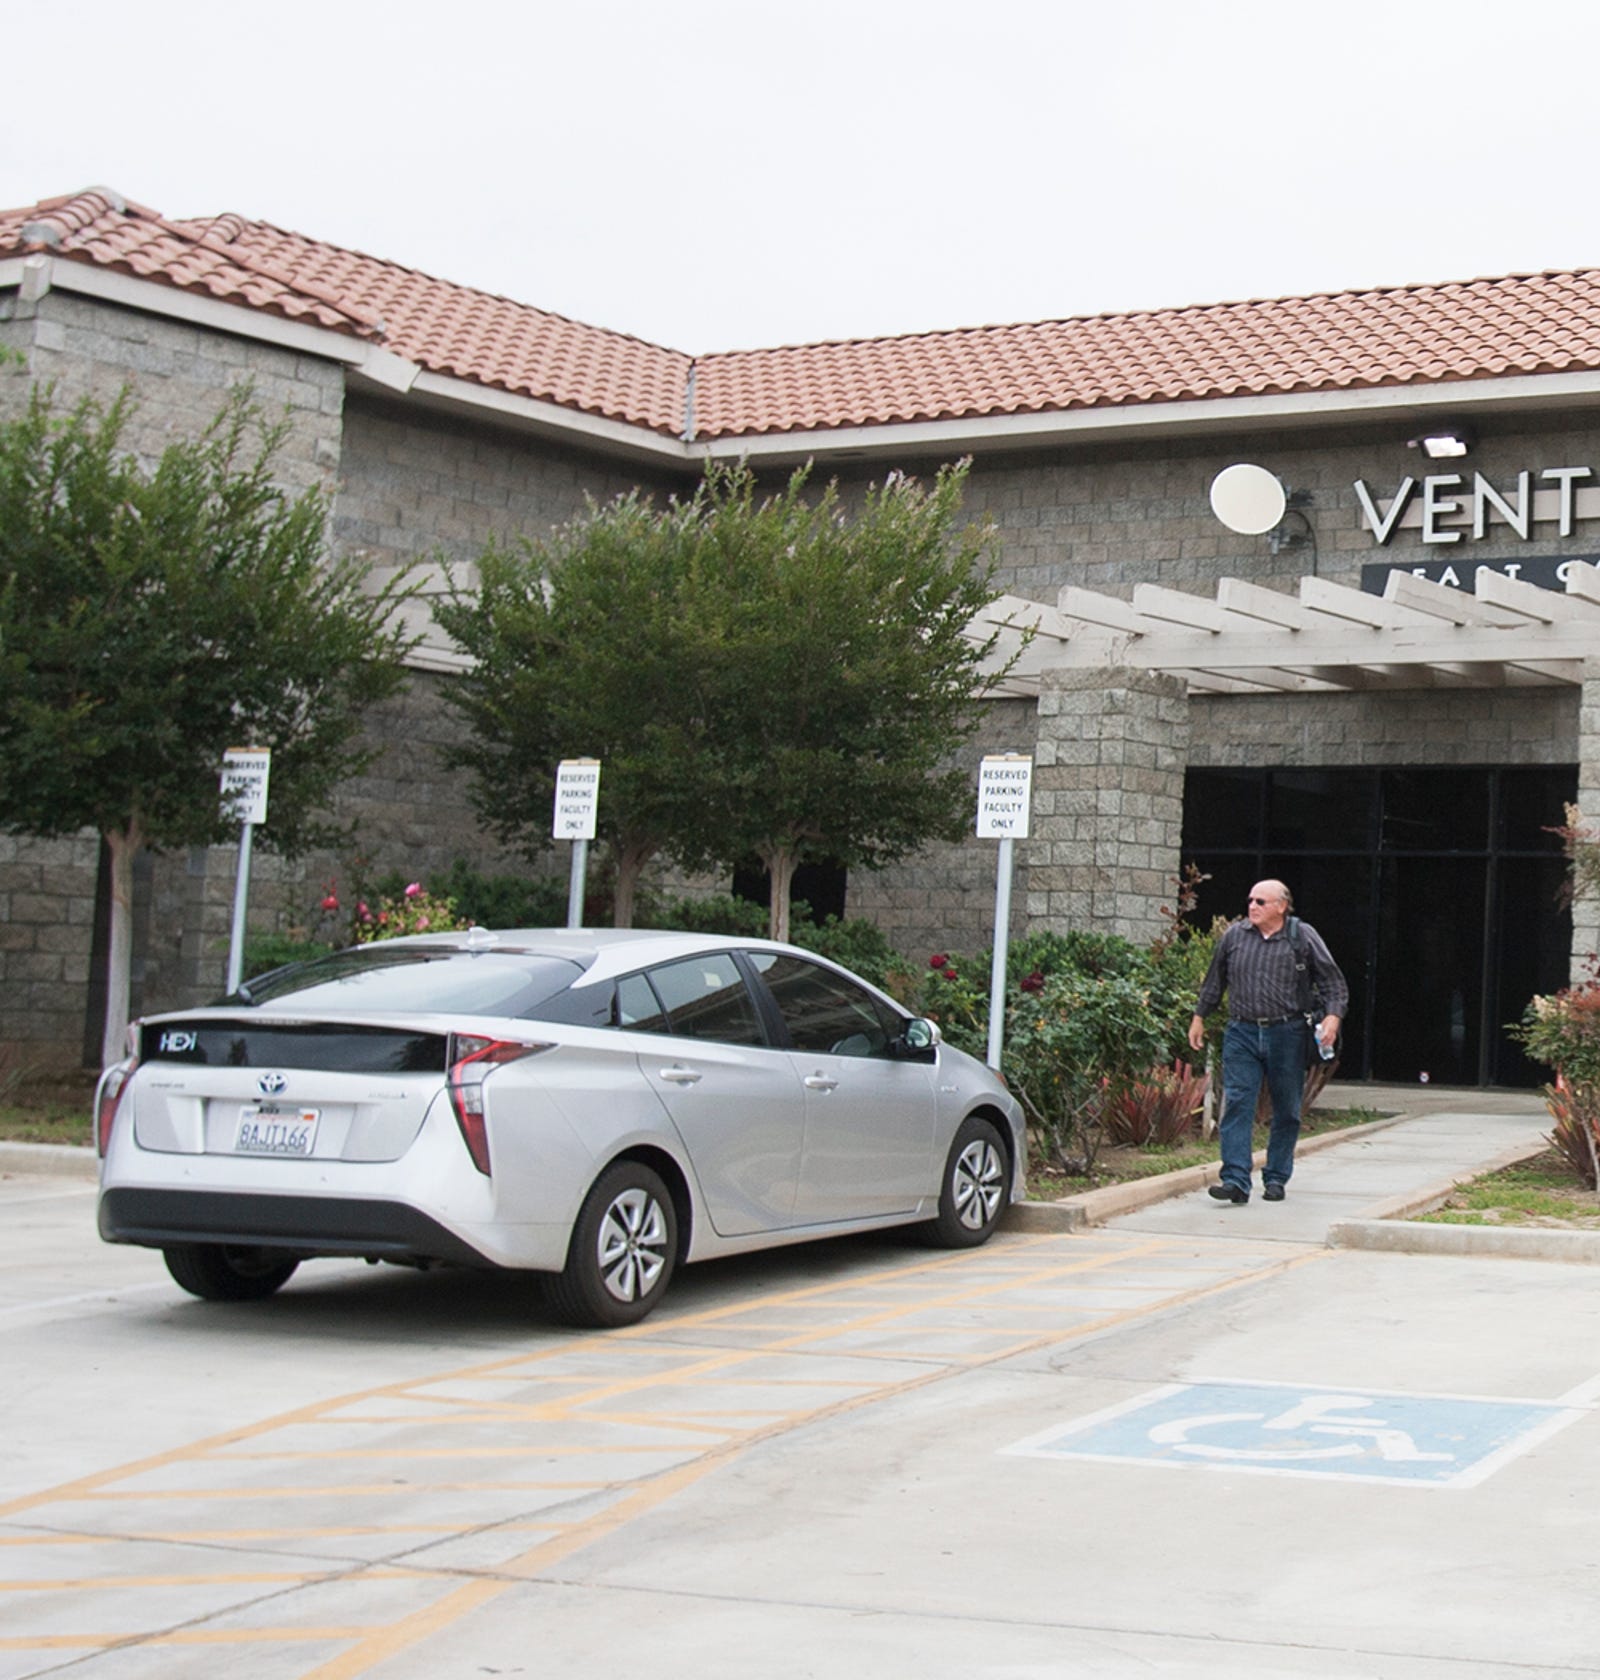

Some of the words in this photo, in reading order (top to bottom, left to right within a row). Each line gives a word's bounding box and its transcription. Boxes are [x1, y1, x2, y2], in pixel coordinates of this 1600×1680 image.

[1411, 563, 1523, 587] EAT
[560, 774, 596, 783] RESERVED
[983, 770, 1028, 780] RESERVED
[561, 789, 592, 799] PARKING
[984, 785, 1024, 797] PARKING
[560, 804, 591, 815] FACULTY
[983, 802, 1024, 813] FACULTY
[565, 820, 584, 831] ONLY
[991, 818, 1015, 829] ONLY
[239, 1124, 309, 1149] 8AJT166
